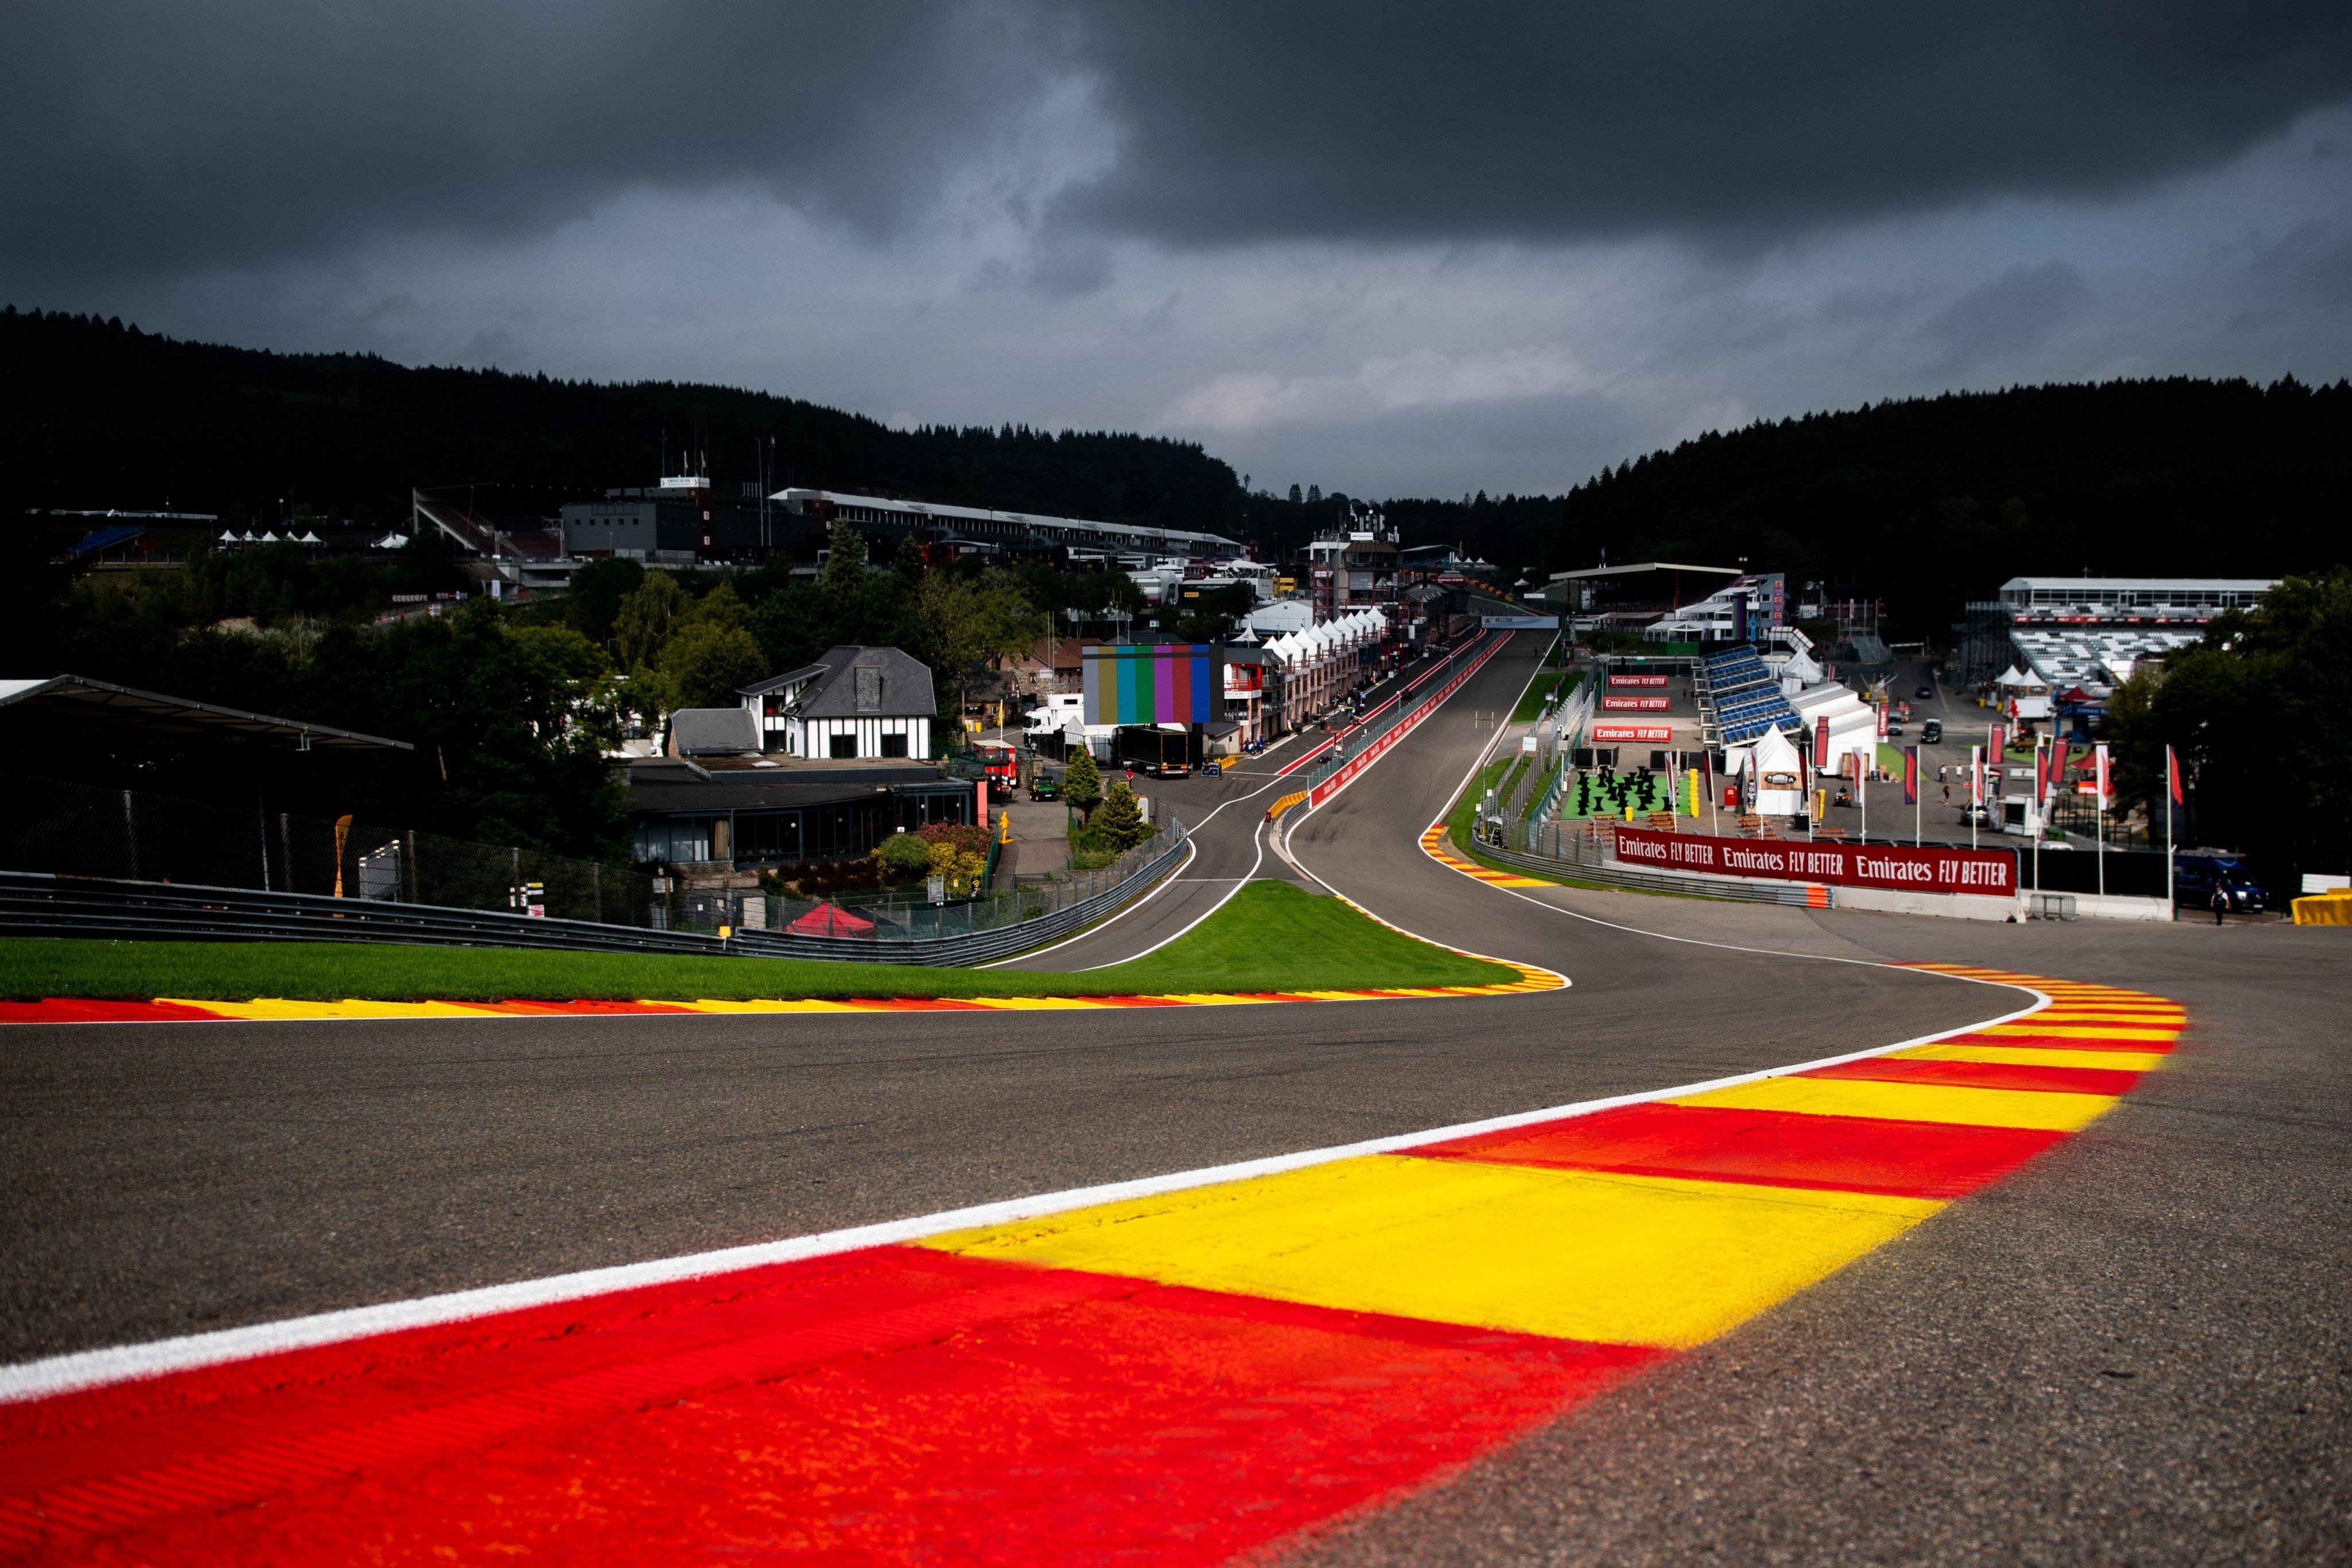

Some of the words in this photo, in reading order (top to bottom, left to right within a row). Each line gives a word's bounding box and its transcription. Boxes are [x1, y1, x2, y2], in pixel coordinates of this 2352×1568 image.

[1606, 699, 1638, 707] Emirates
[1649, 700, 1666, 708] BETTER
[1597, 729, 1635, 738] Emirates
[1637, 729, 1647, 738] FLY
[1647, 729, 1669, 738] BETTER
[1619, 835, 1667, 859] Emirates
[1670, 842, 1682, 861] FLY
[1685, 843, 1713, 865] BETTER
[1723, 847, 1784, 871] Emirates
[1789, 851, 1805, 872] FLY
[1808, 852, 1843, 876] BETTER
[1855, 855, 1932, 882] Emirates
[1939, 860, 1959, 884] FLY
[1961, 861, 2006, 886] BETTER
